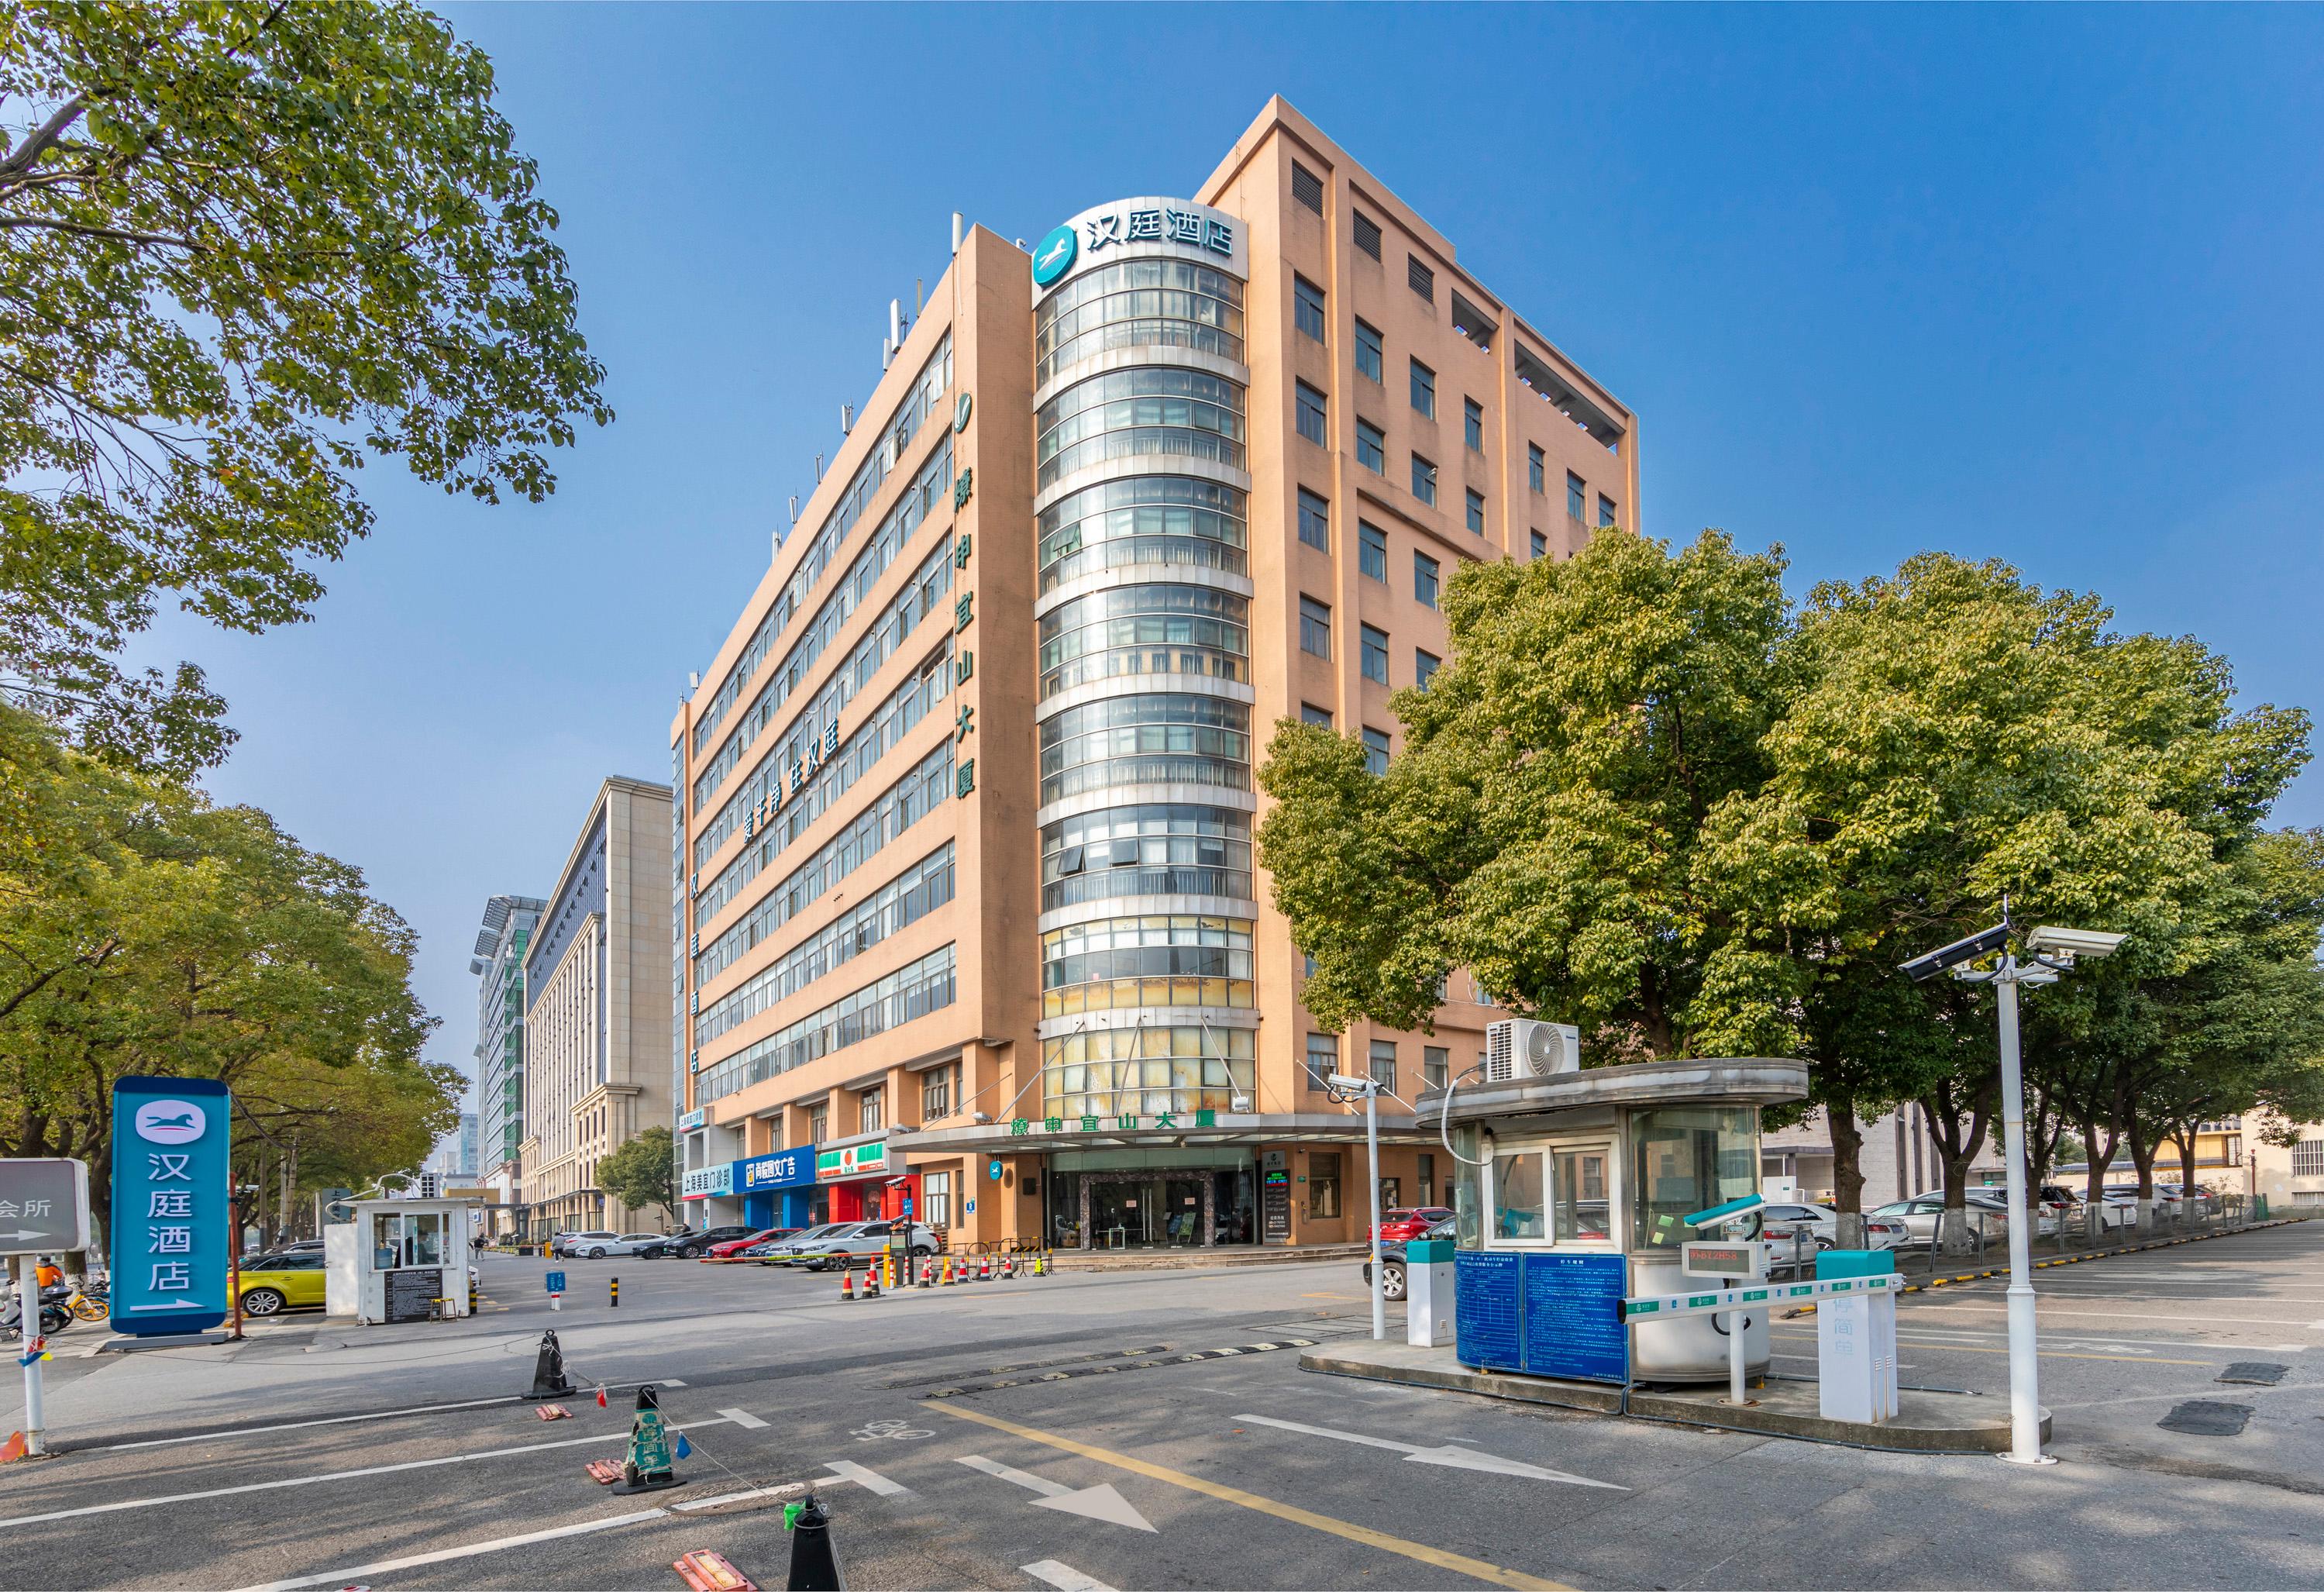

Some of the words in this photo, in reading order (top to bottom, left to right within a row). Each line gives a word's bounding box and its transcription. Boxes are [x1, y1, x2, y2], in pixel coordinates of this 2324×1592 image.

[1087, 207, 1232, 256] 汉庭酒店
[685, 1168, 730, 1192] 上海美宜门诊部
[0, 1200, 52, 1218] 会所
[147, 1153, 193, 1290] 汉庭酒店
